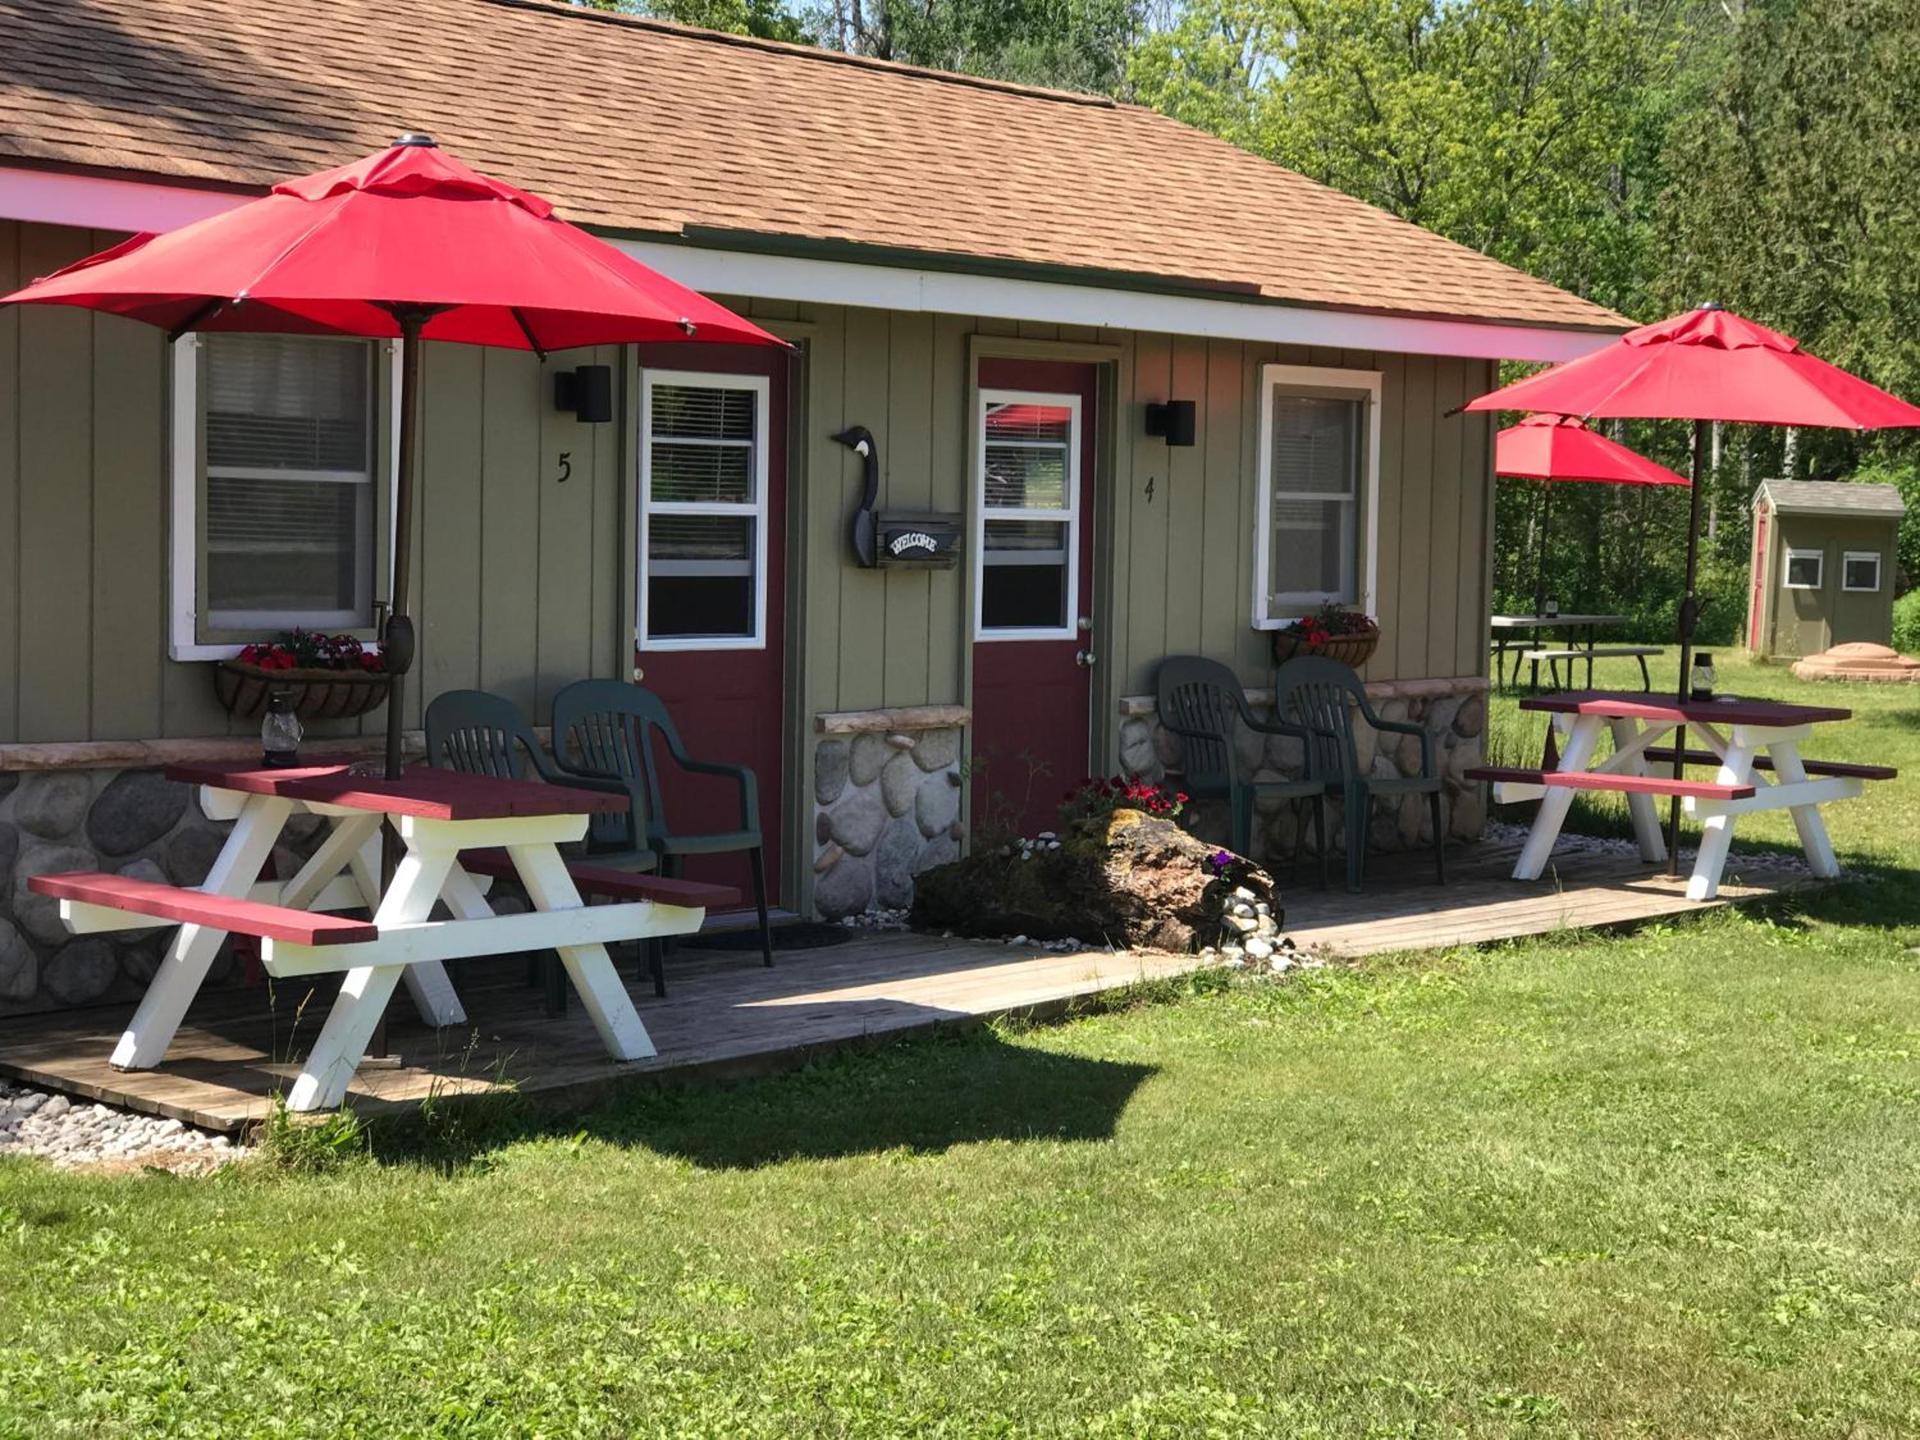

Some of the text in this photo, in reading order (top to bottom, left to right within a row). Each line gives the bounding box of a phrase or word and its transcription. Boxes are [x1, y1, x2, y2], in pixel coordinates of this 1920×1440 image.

[557, 452, 571, 483] 5
[1144, 476, 1154, 504] 4
[889, 532, 938, 555] WELCOME
